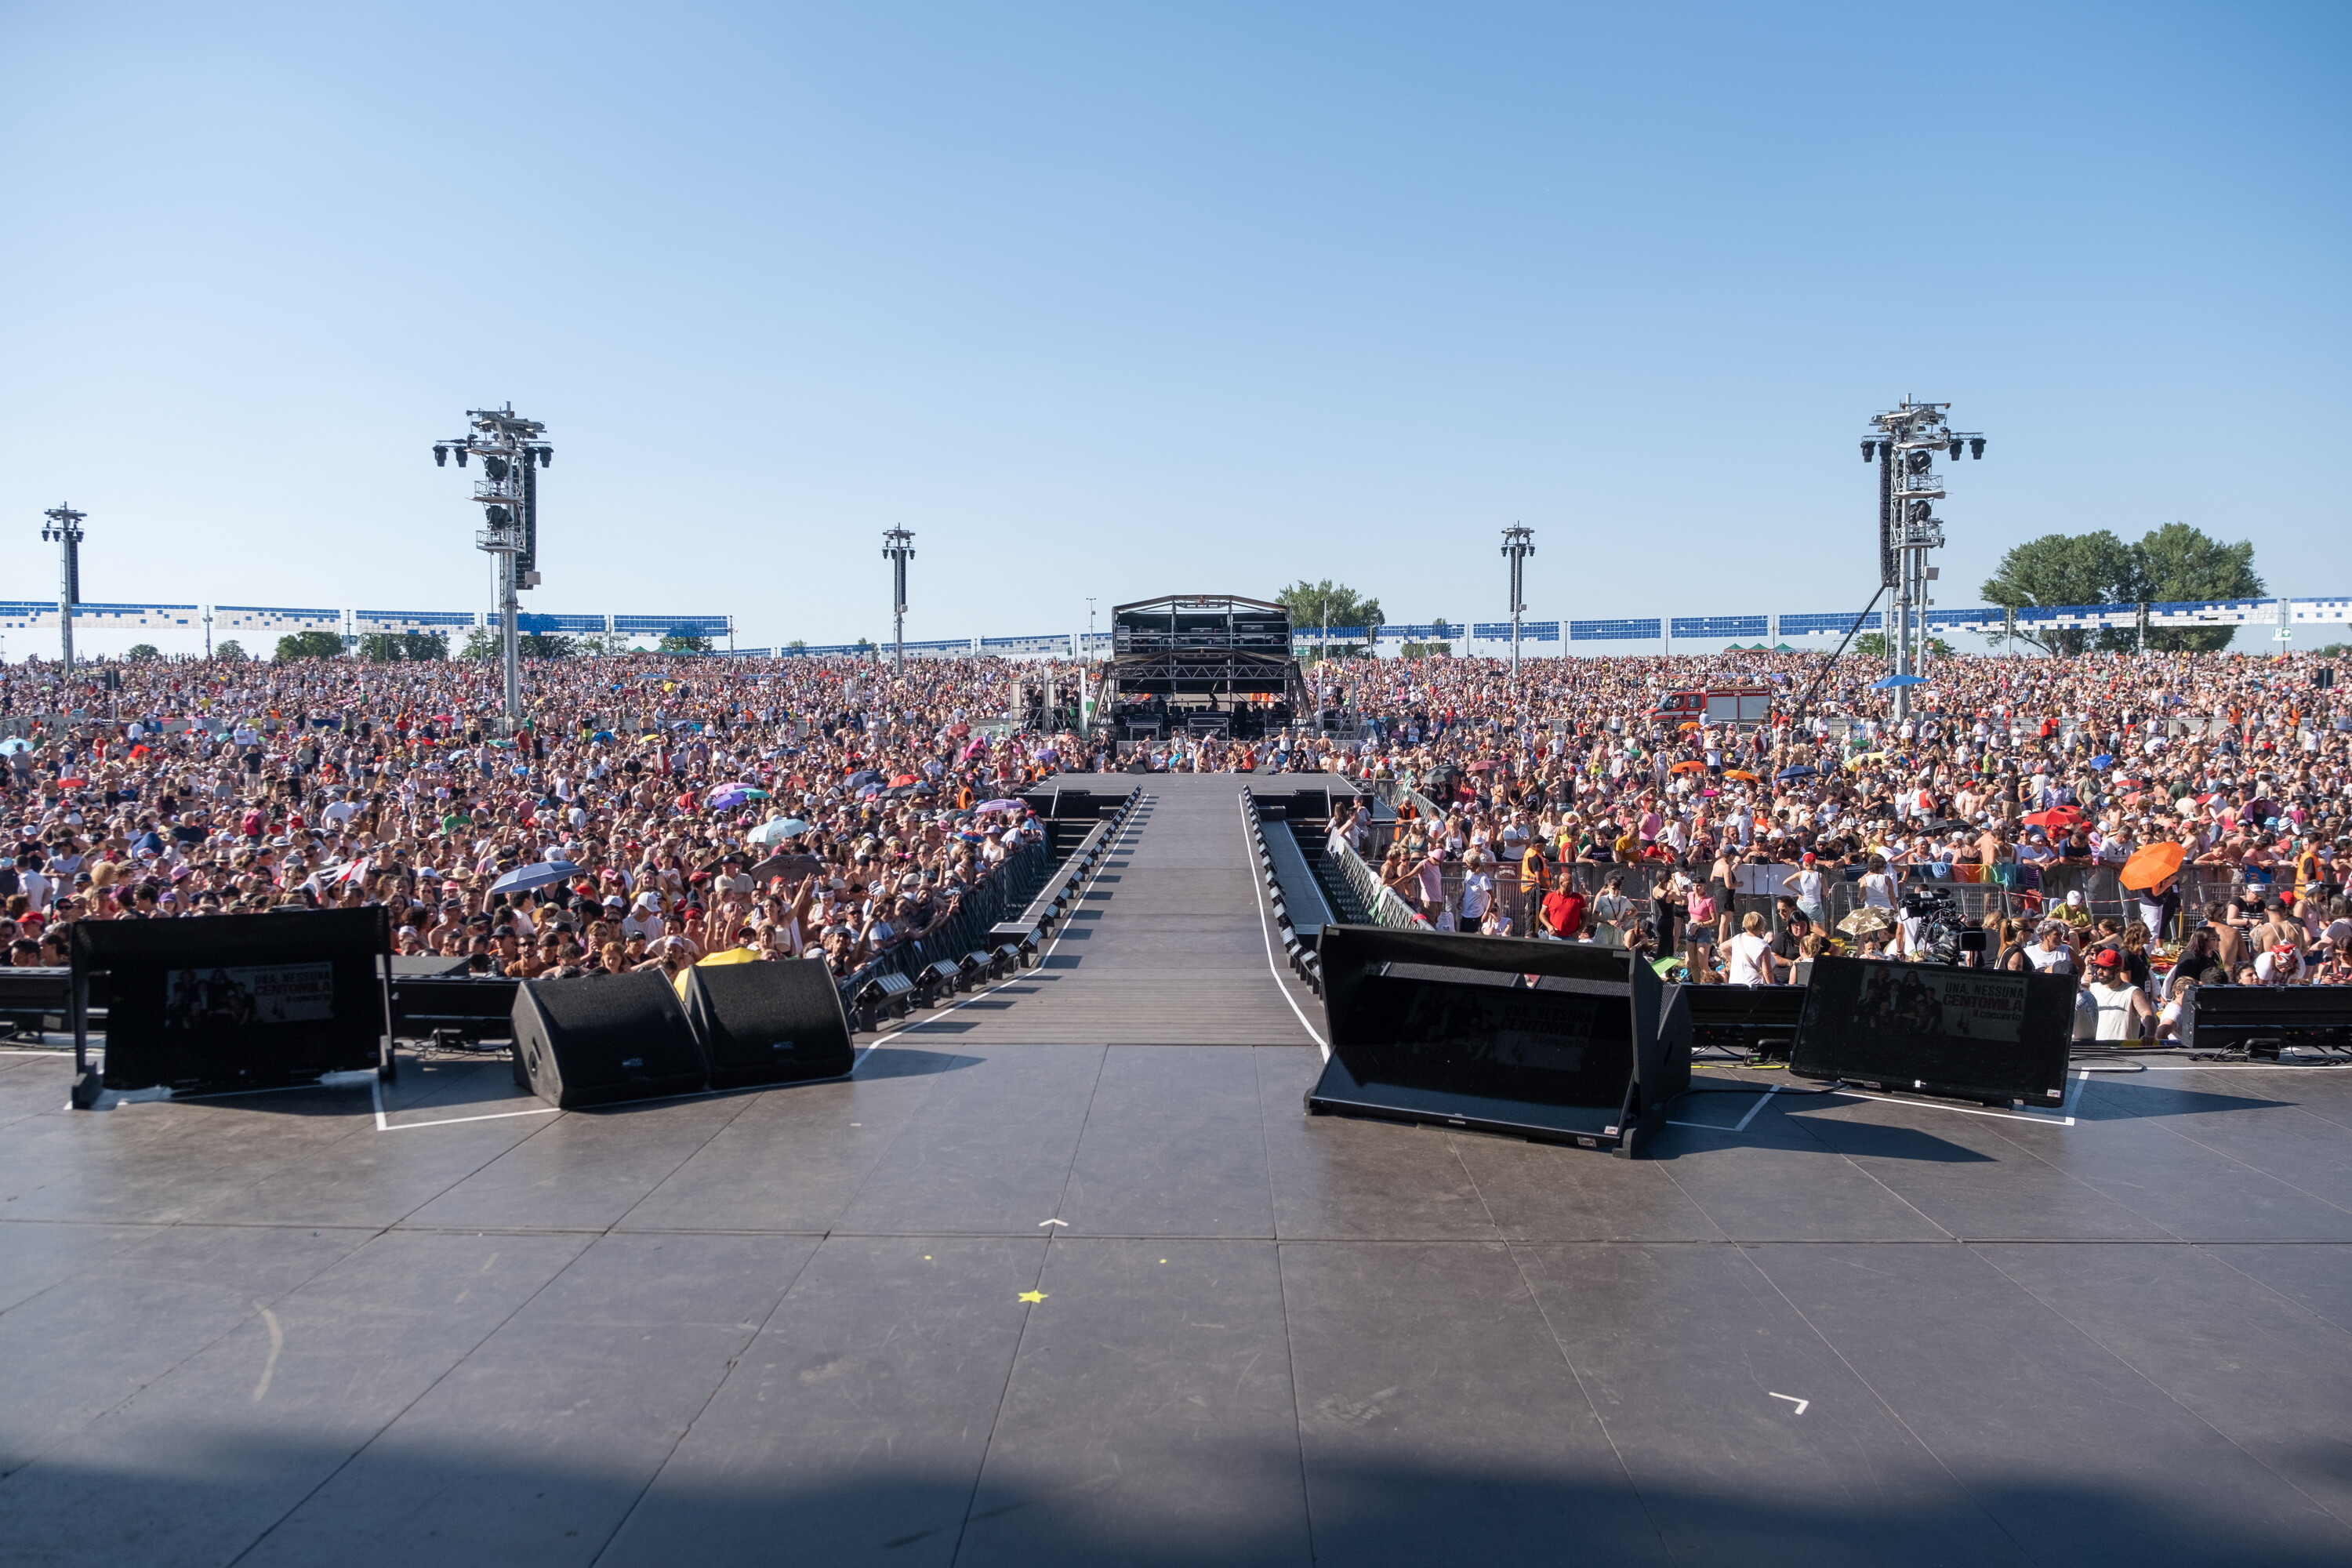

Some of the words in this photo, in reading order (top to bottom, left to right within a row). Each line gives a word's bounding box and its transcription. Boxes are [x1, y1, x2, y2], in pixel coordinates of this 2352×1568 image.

[1974, 984, 2024, 998] NESSUNA
[1943, 993, 2023, 1011] CENTOMILA
[1537, 1007, 1593, 1022] NESSUNA
[1980, 1011, 2021, 1022] concerto
[1499, 1017, 1590, 1037] CENTOMILA
